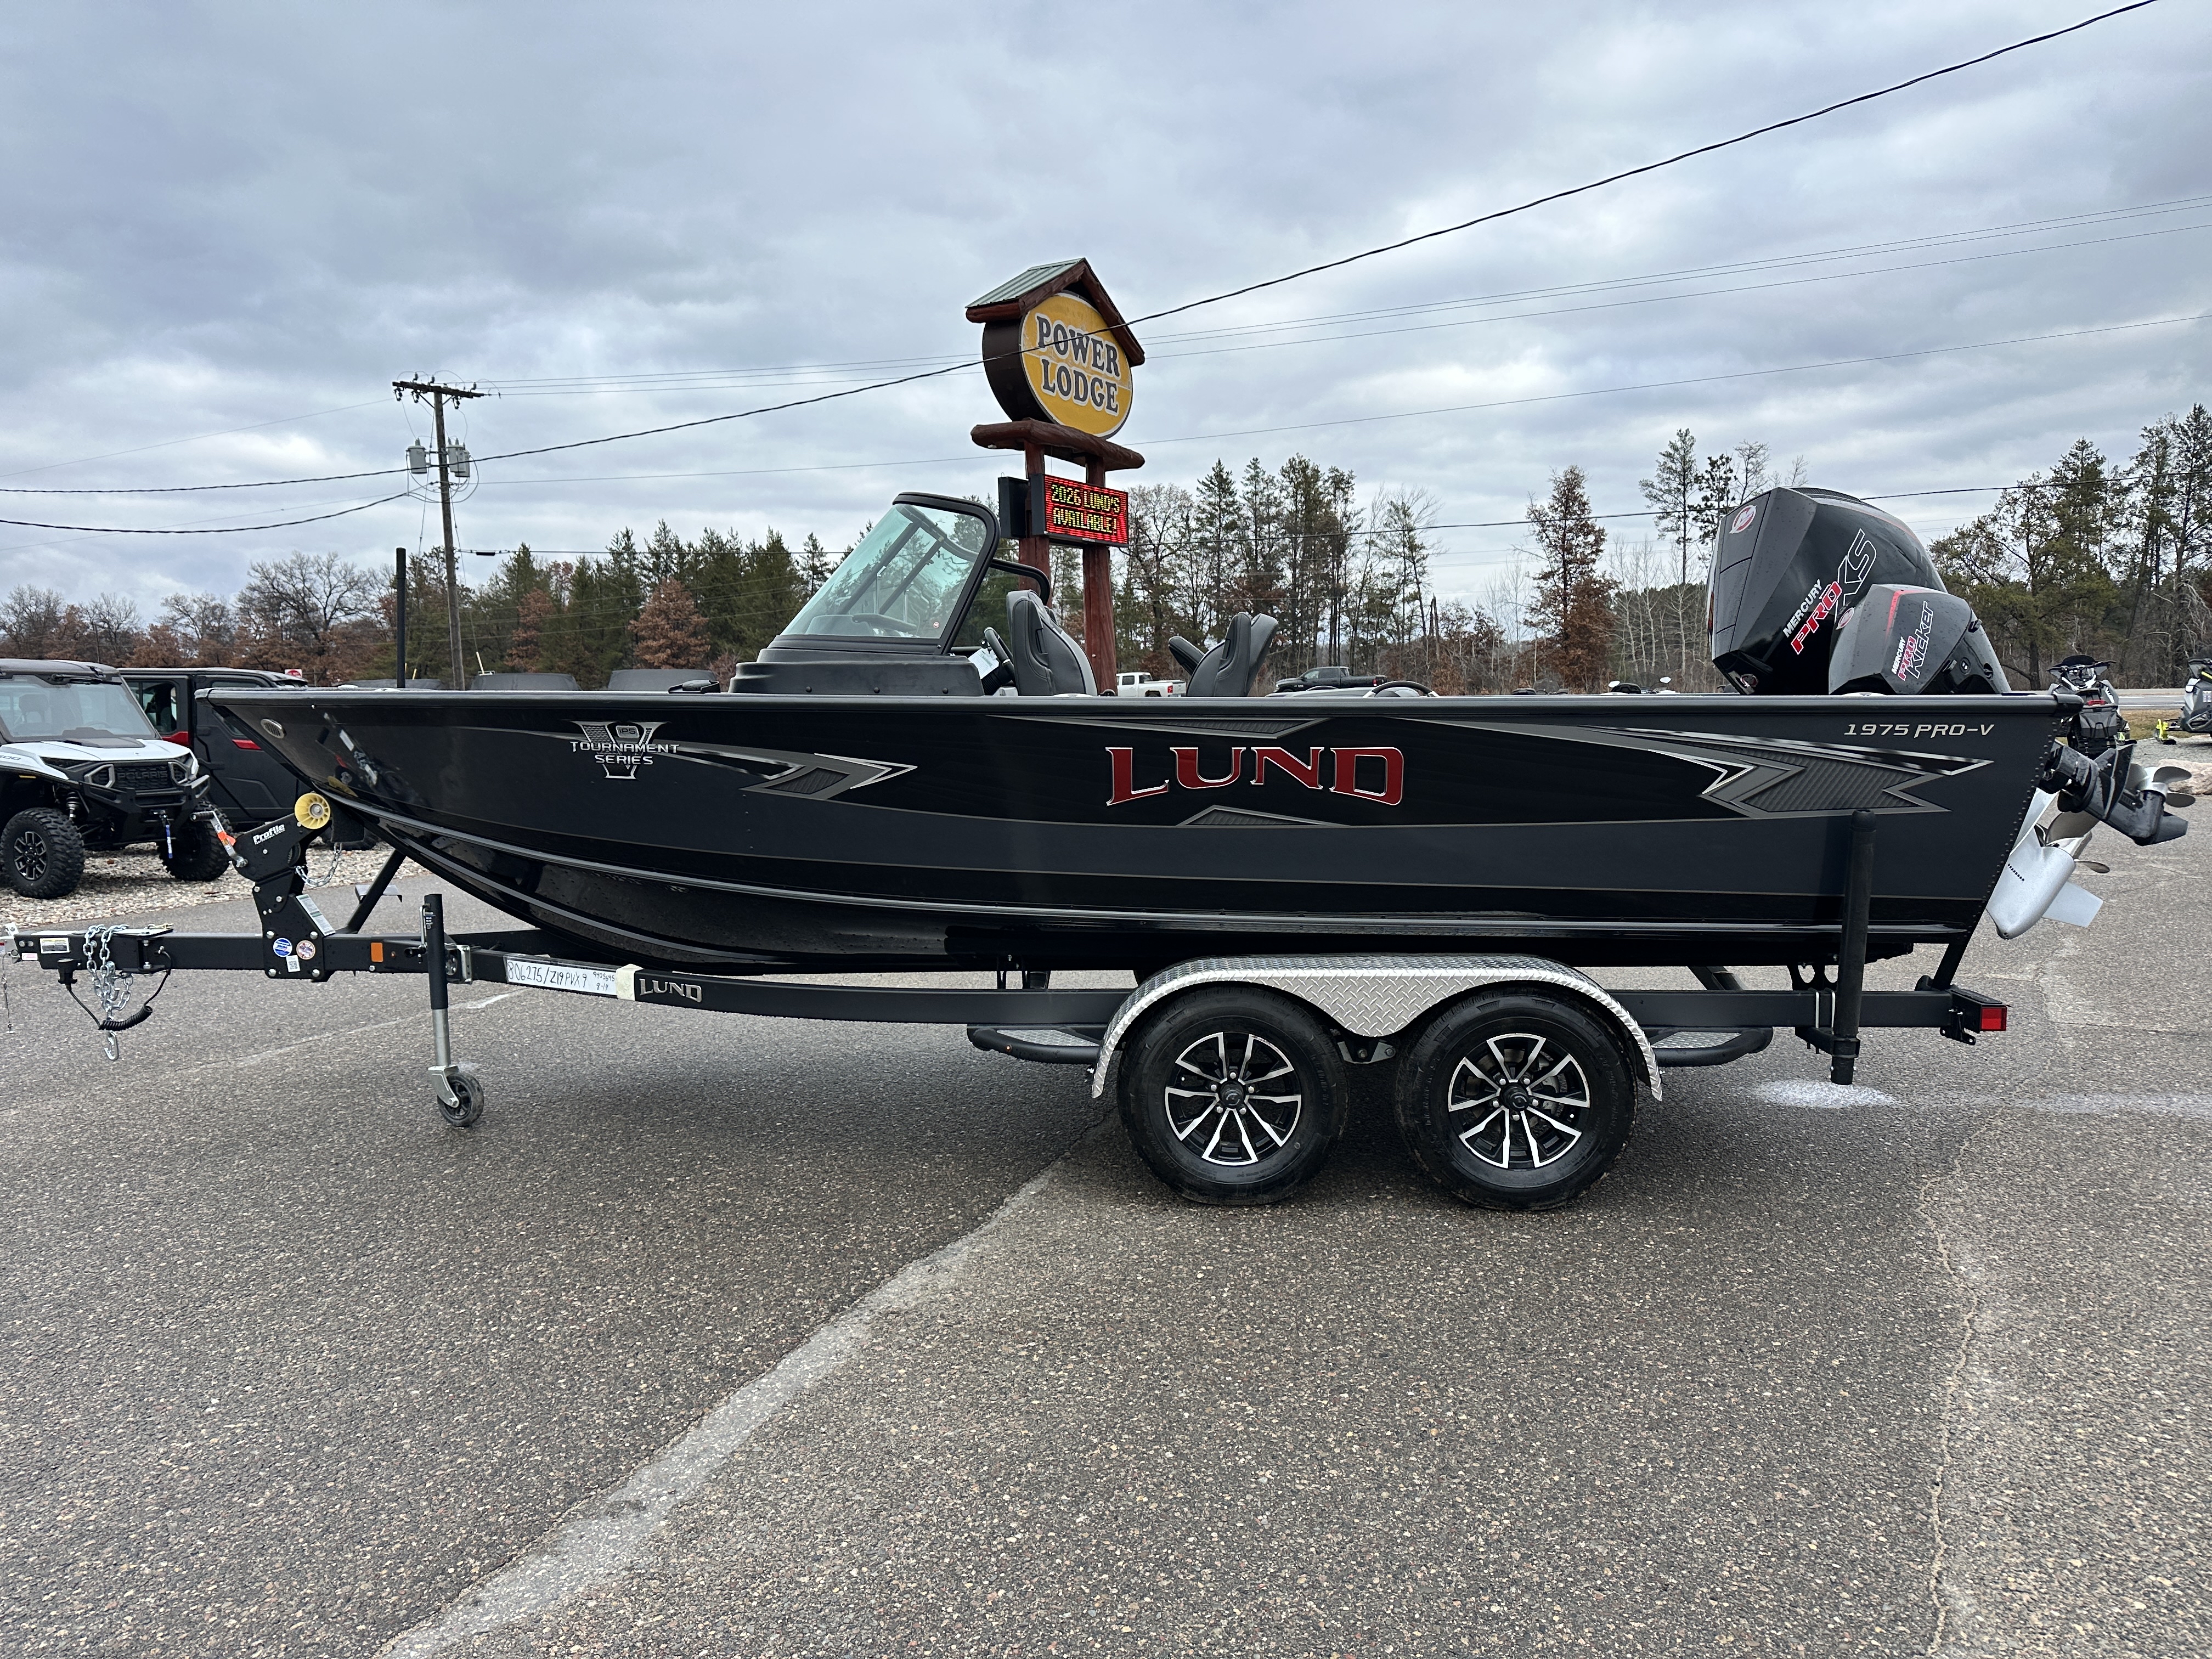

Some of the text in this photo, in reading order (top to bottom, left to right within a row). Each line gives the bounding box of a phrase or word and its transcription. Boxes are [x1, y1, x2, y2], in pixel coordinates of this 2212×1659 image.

[1036, 315, 1120, 377] POWER
[1041, 358, 1119, 413] LODGE
[1051, 484, 1120, 513] 2026 LUND'S
[1053, 507, 1117, 534] AVAILABLE!
[1790, 528, 1877, 655] PRO XS
[1782, 578, 1822, 638] MERCURY
[1891, 636, 1906, 675] MERCURY
[1897, 635, 1917, 681] PRO
[1843, 724, 1995, 738] 1975 PRO-V
[569, 741, 680, 753] TOURNAMENT
[594, 754, 654, 765] SERIES
[117, 770, 168, 780] POLARIS
[1105, 746, 1405, 806] LUND
[252, 824, 285, 845] Profile
[639, 978, 702, 1003] LUND
